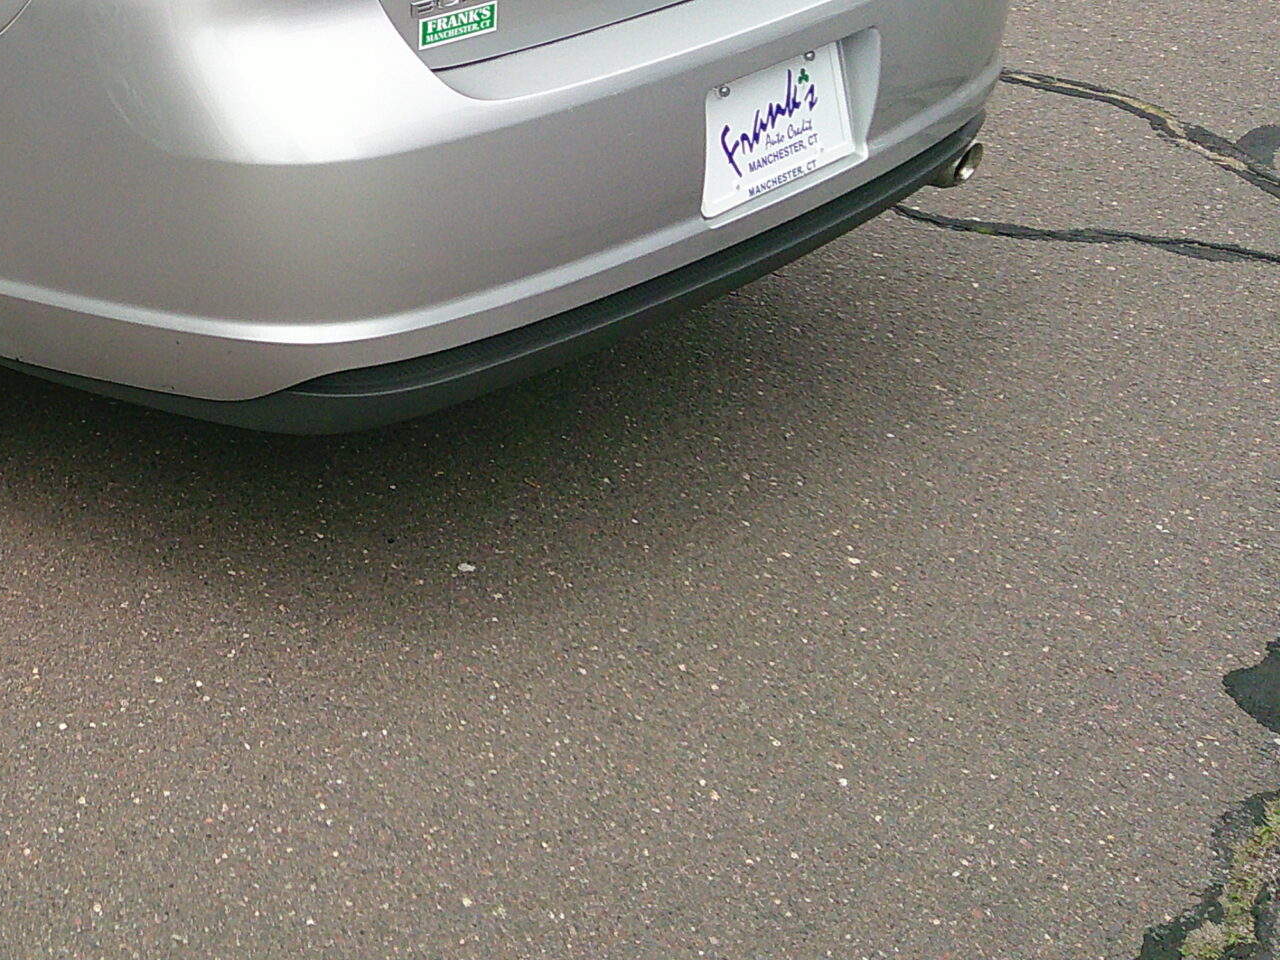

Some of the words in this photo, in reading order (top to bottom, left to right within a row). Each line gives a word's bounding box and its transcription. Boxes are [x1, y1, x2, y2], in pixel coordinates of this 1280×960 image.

[426, 6, 491, 33] FRANK'S
[720, 68, 818, 177] Frank's
[765, 133, 785, 149] Auto
[787, 119, 813, 139] Credit
[748, 139, 807, 173] MANCHESTER,
[807, 133, 818, 146] CT
[806, 159, 818, 171] CT
